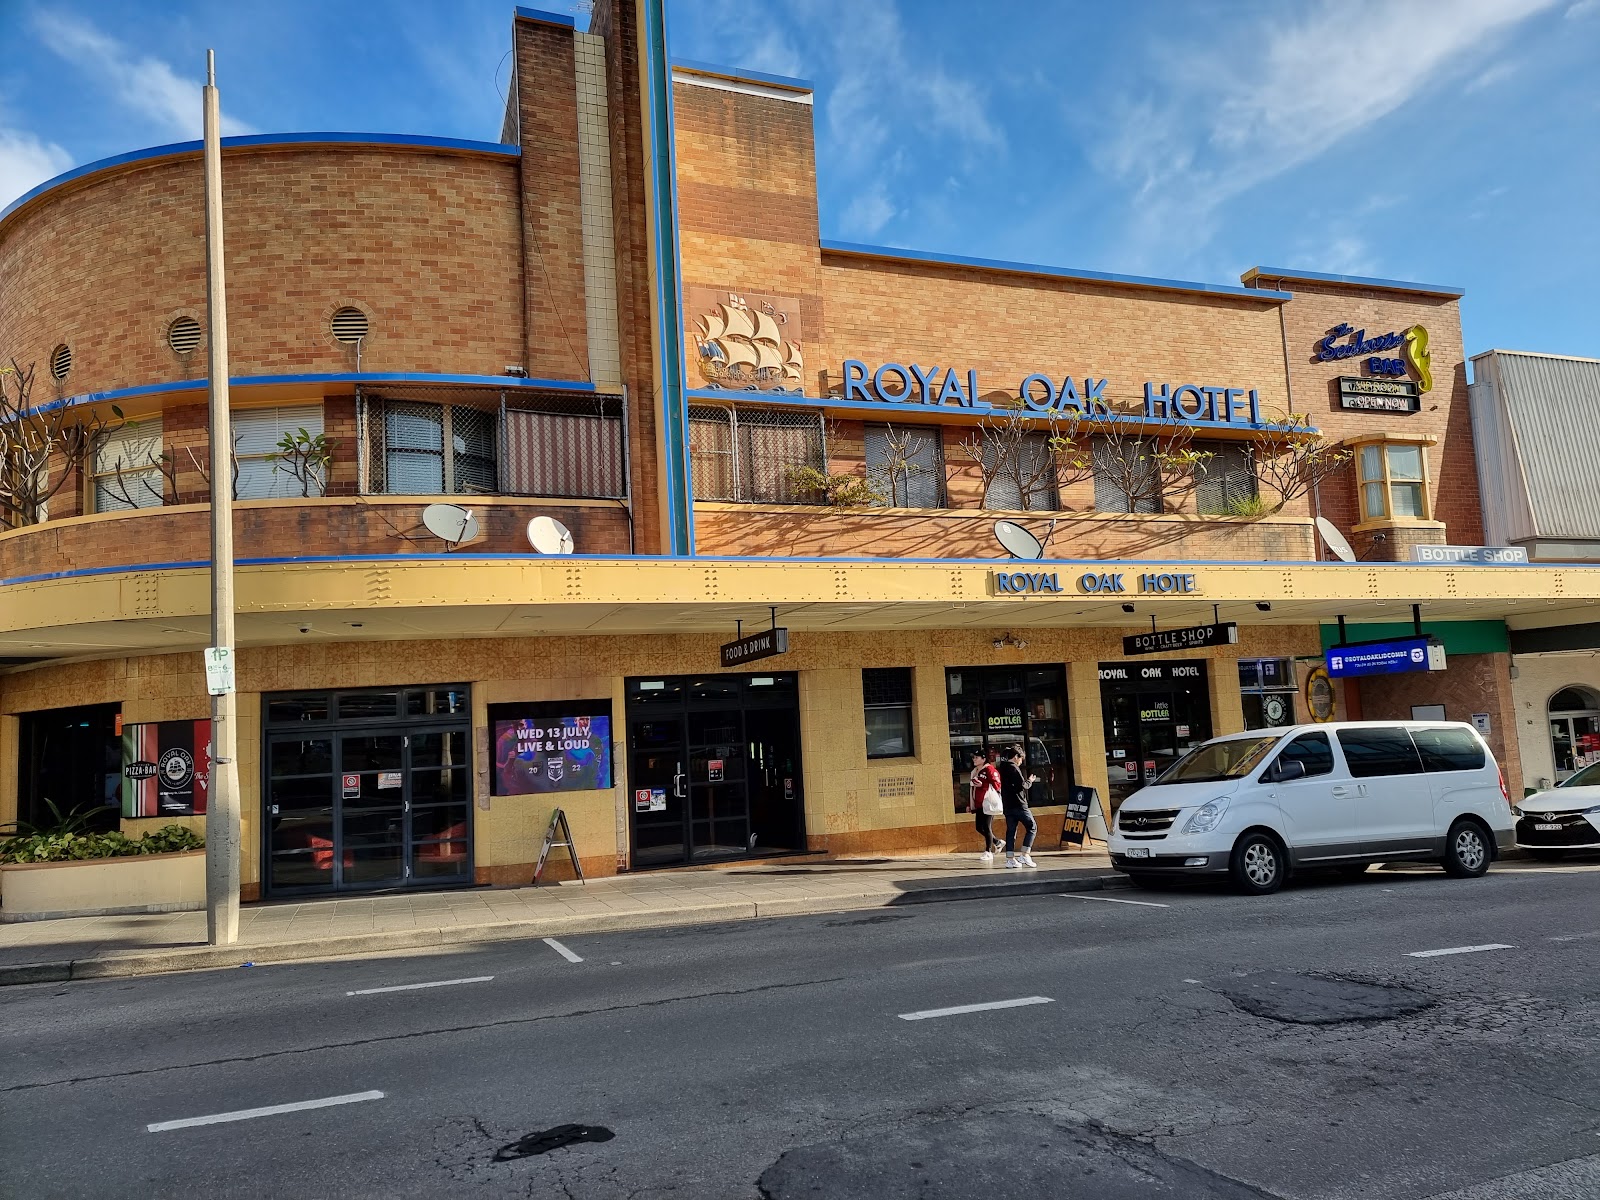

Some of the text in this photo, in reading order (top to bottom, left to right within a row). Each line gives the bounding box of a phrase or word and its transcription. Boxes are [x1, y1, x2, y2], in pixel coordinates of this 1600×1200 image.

[1368, 357, 1406, 375] BAR
[843, 359, 1267, 424] ROYAL OAK HOTEL
[1357, 395, 1408, 409] OPEN NOW
[1422, 548, 1523, 561] BOTTLE SHOP
[999, 572, 1064, 592] ROYAL
[1081, 573, 1126, 592] OAK
[1135, 627, 1214, 648] BOTTLE SHOP
[725, 636, 771, 661] FOOD & DRINK
[1098, 666, 1200, 680] ROYAL OAK HOTEL
[1004, 707, 1021, 716] little
[1155, 702, 1169, 710] little
[988, 715, 1022, 726] BOTTLER
[1140, 709, 1170, 719] BOTTLER
[516, 726, 592, 740] WED 13 JULY,
[517, 739, 590, 753] LIVE & LOUD
[160, 750, 192, 768] ROYAL OAK
[125, 765, 157, 776] PIZZA BAR
[571, 764, 581, 772] 22
[1063, 818, 1085, 834] OPEN
